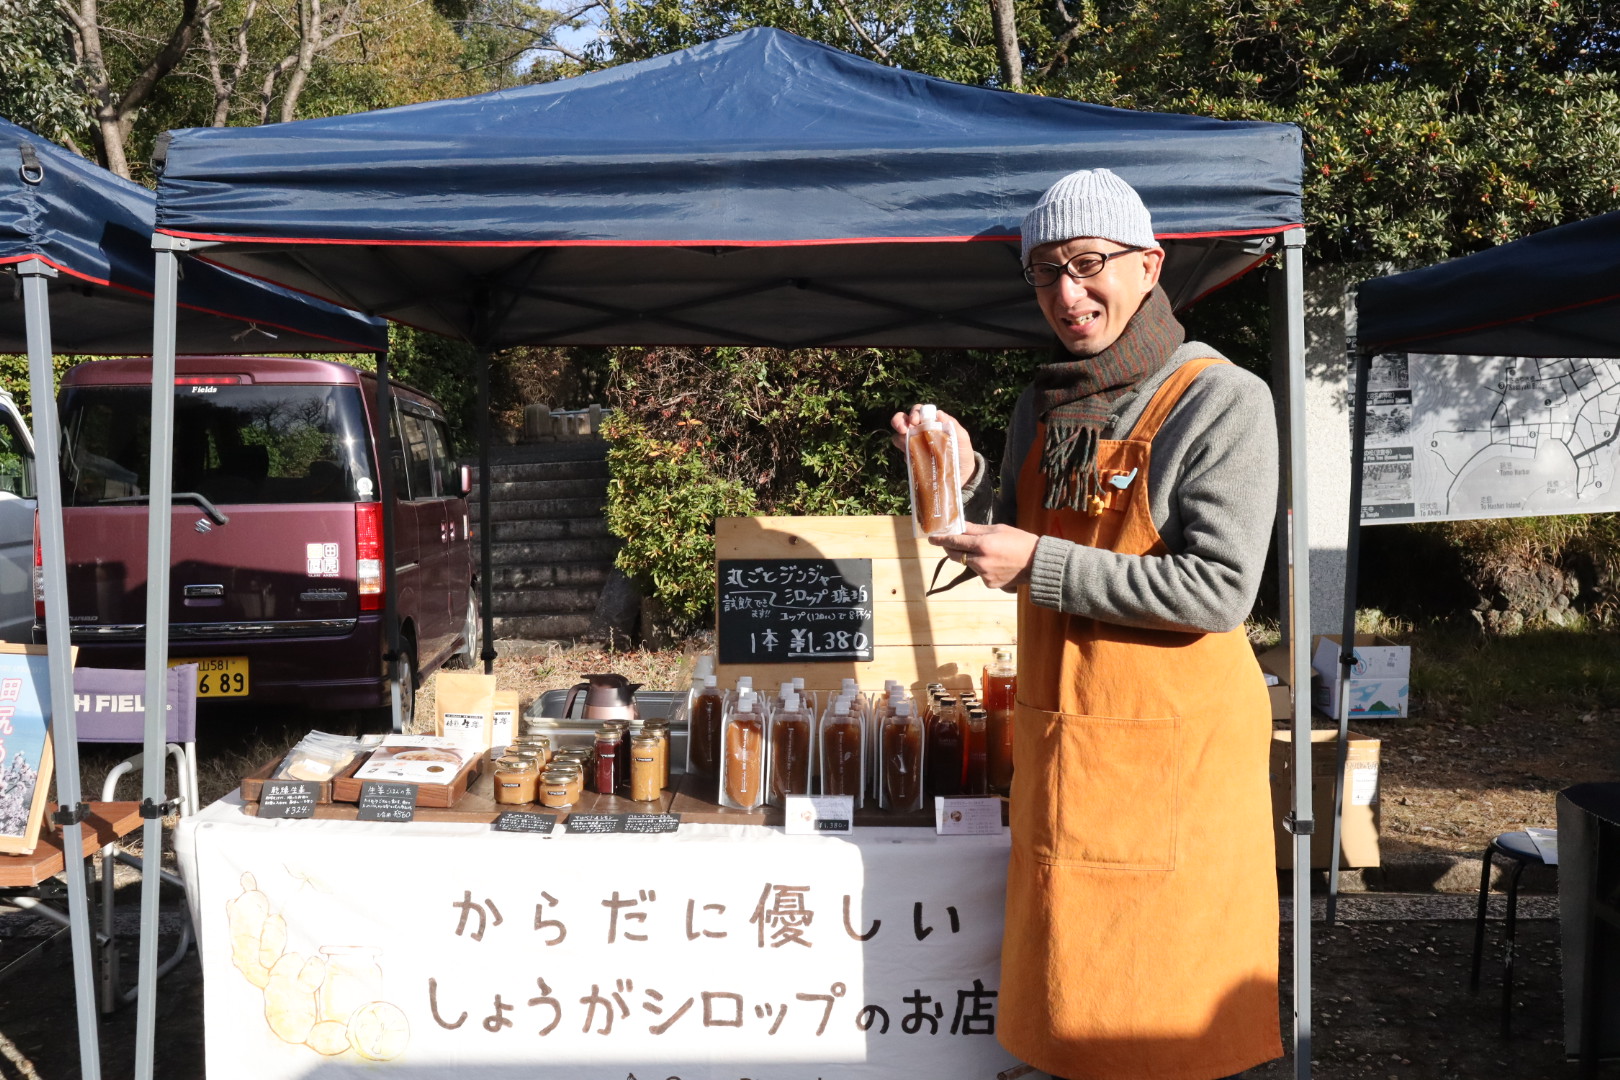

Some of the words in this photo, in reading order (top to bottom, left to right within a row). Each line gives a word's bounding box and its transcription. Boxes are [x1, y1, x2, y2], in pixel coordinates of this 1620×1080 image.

[192, 386, 218, 394] Fields
[95, 694, 146, 713] FIEL
[452, 881, 961, 948] からだに優しい
[427, 976, 999, 1037] しょうがシロップのお店
